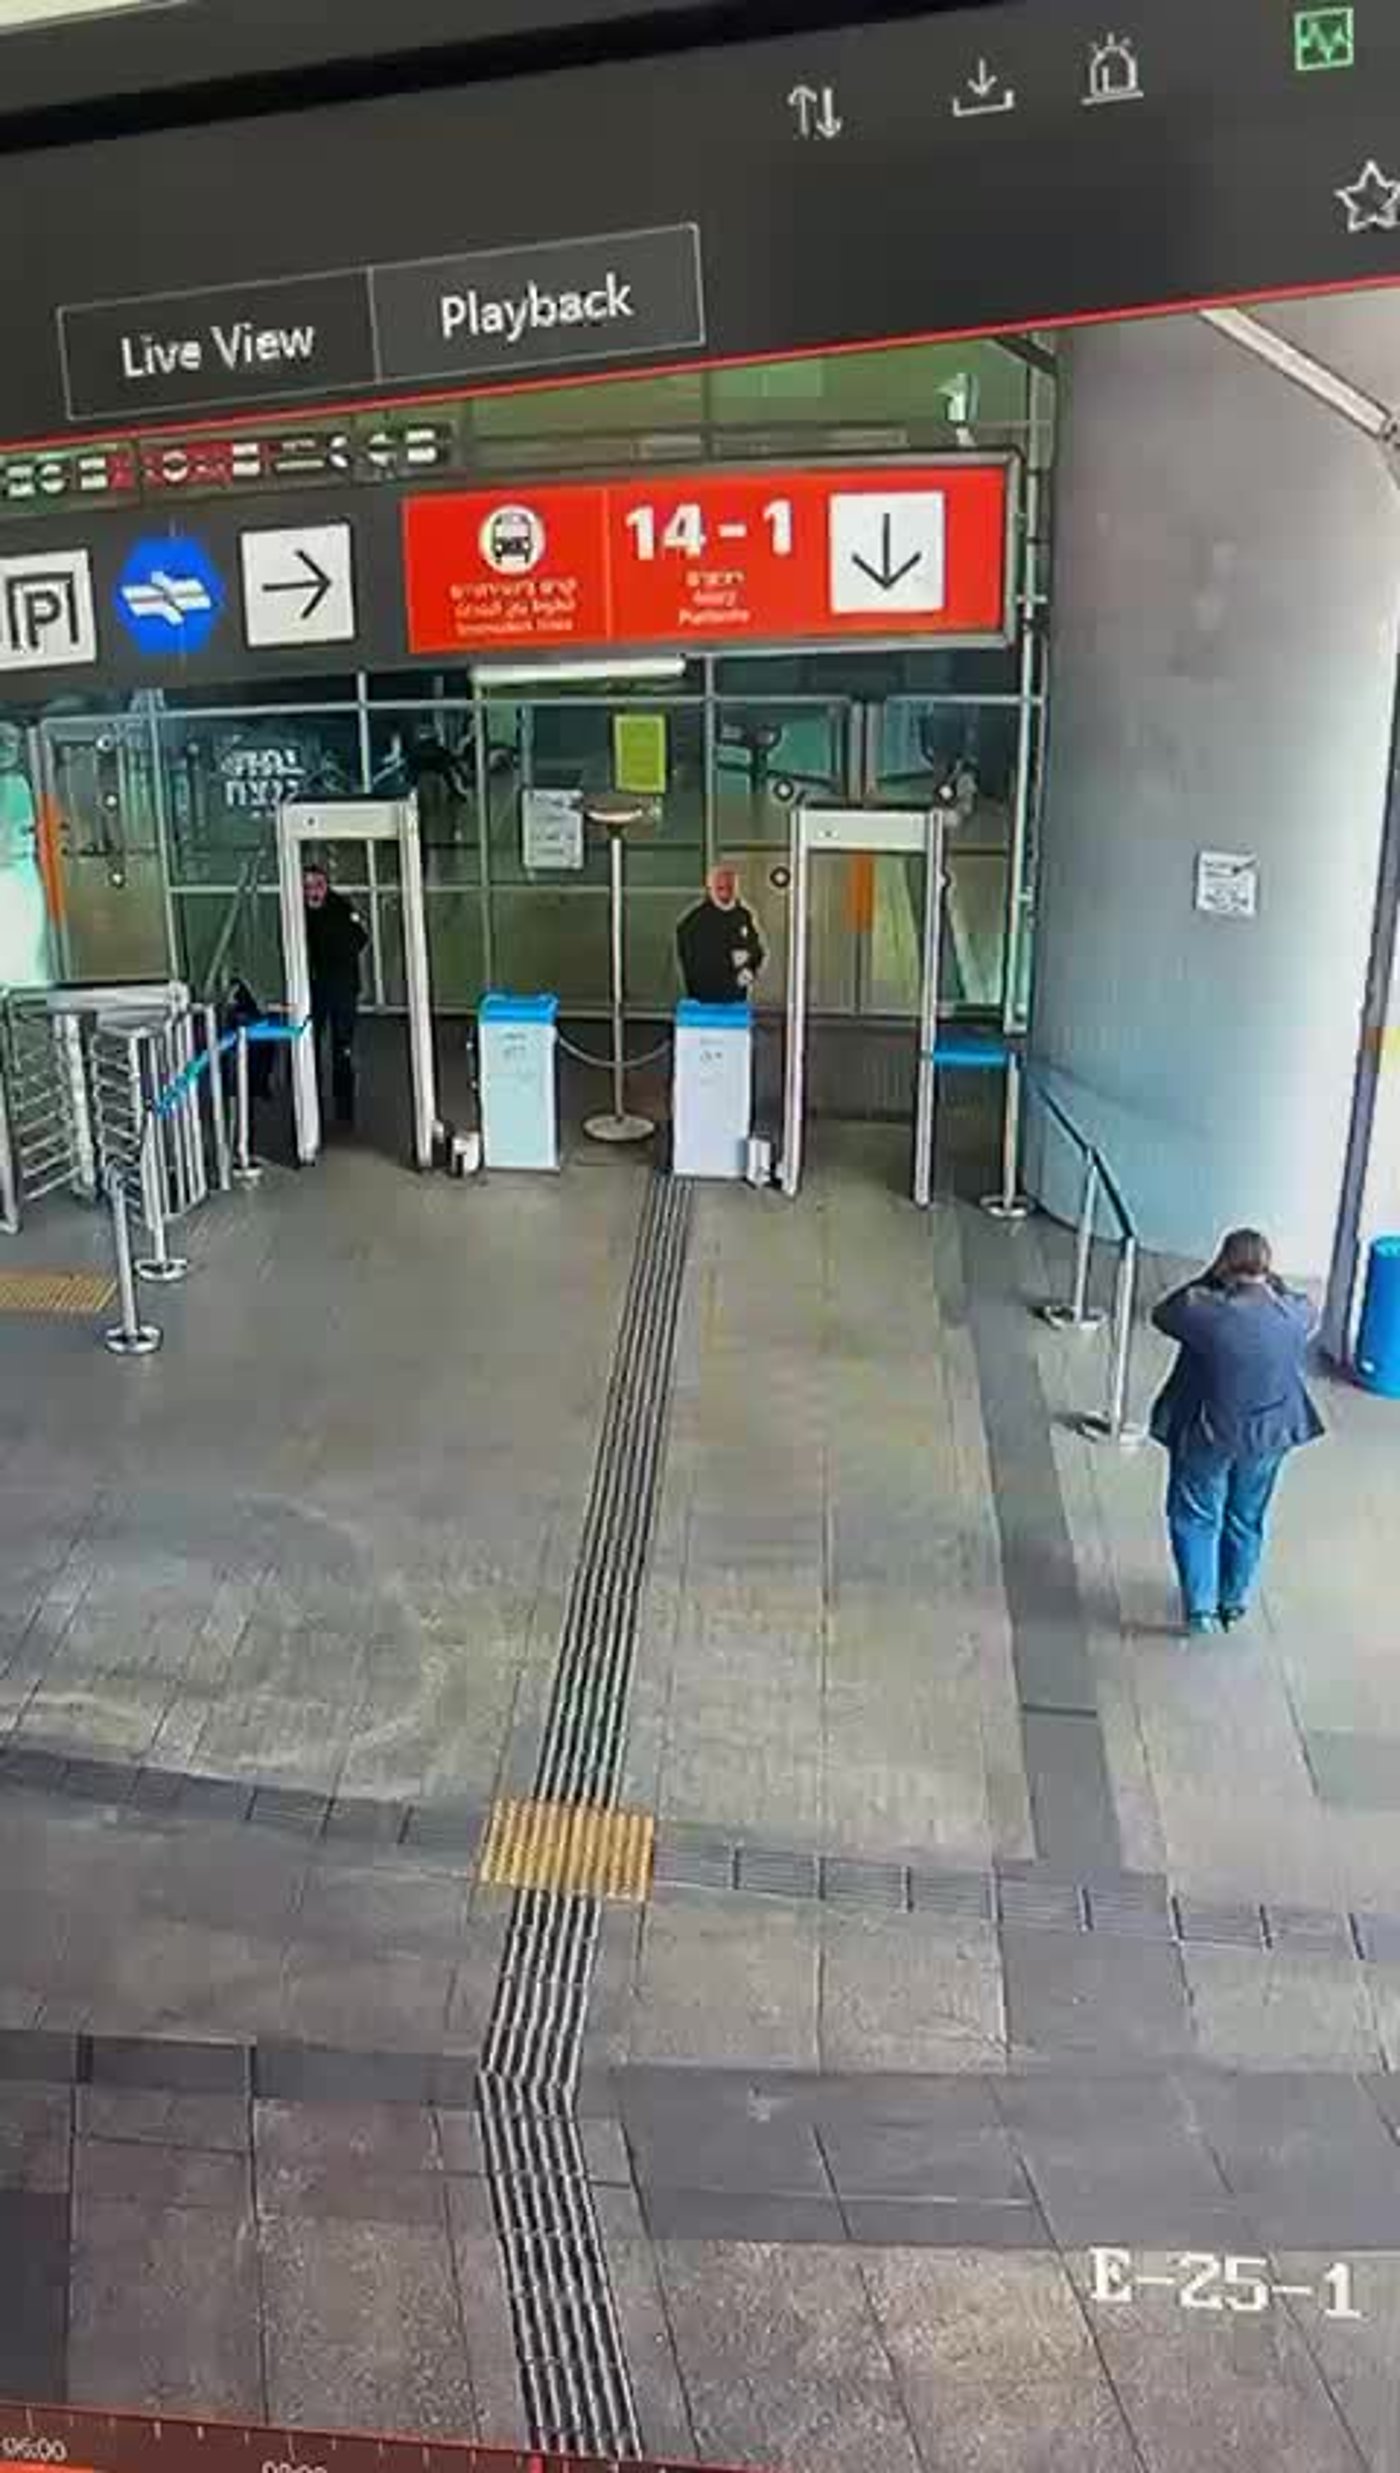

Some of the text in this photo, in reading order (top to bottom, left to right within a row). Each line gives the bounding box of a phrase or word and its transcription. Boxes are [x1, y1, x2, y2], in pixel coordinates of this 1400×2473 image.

[440, 272, 635, 343] Playback
[121, 322, 315, 378] Live View
[1090, 2246, 1362, 2319] E-25-1
[2, 2436, 68, 2463] 06:00
